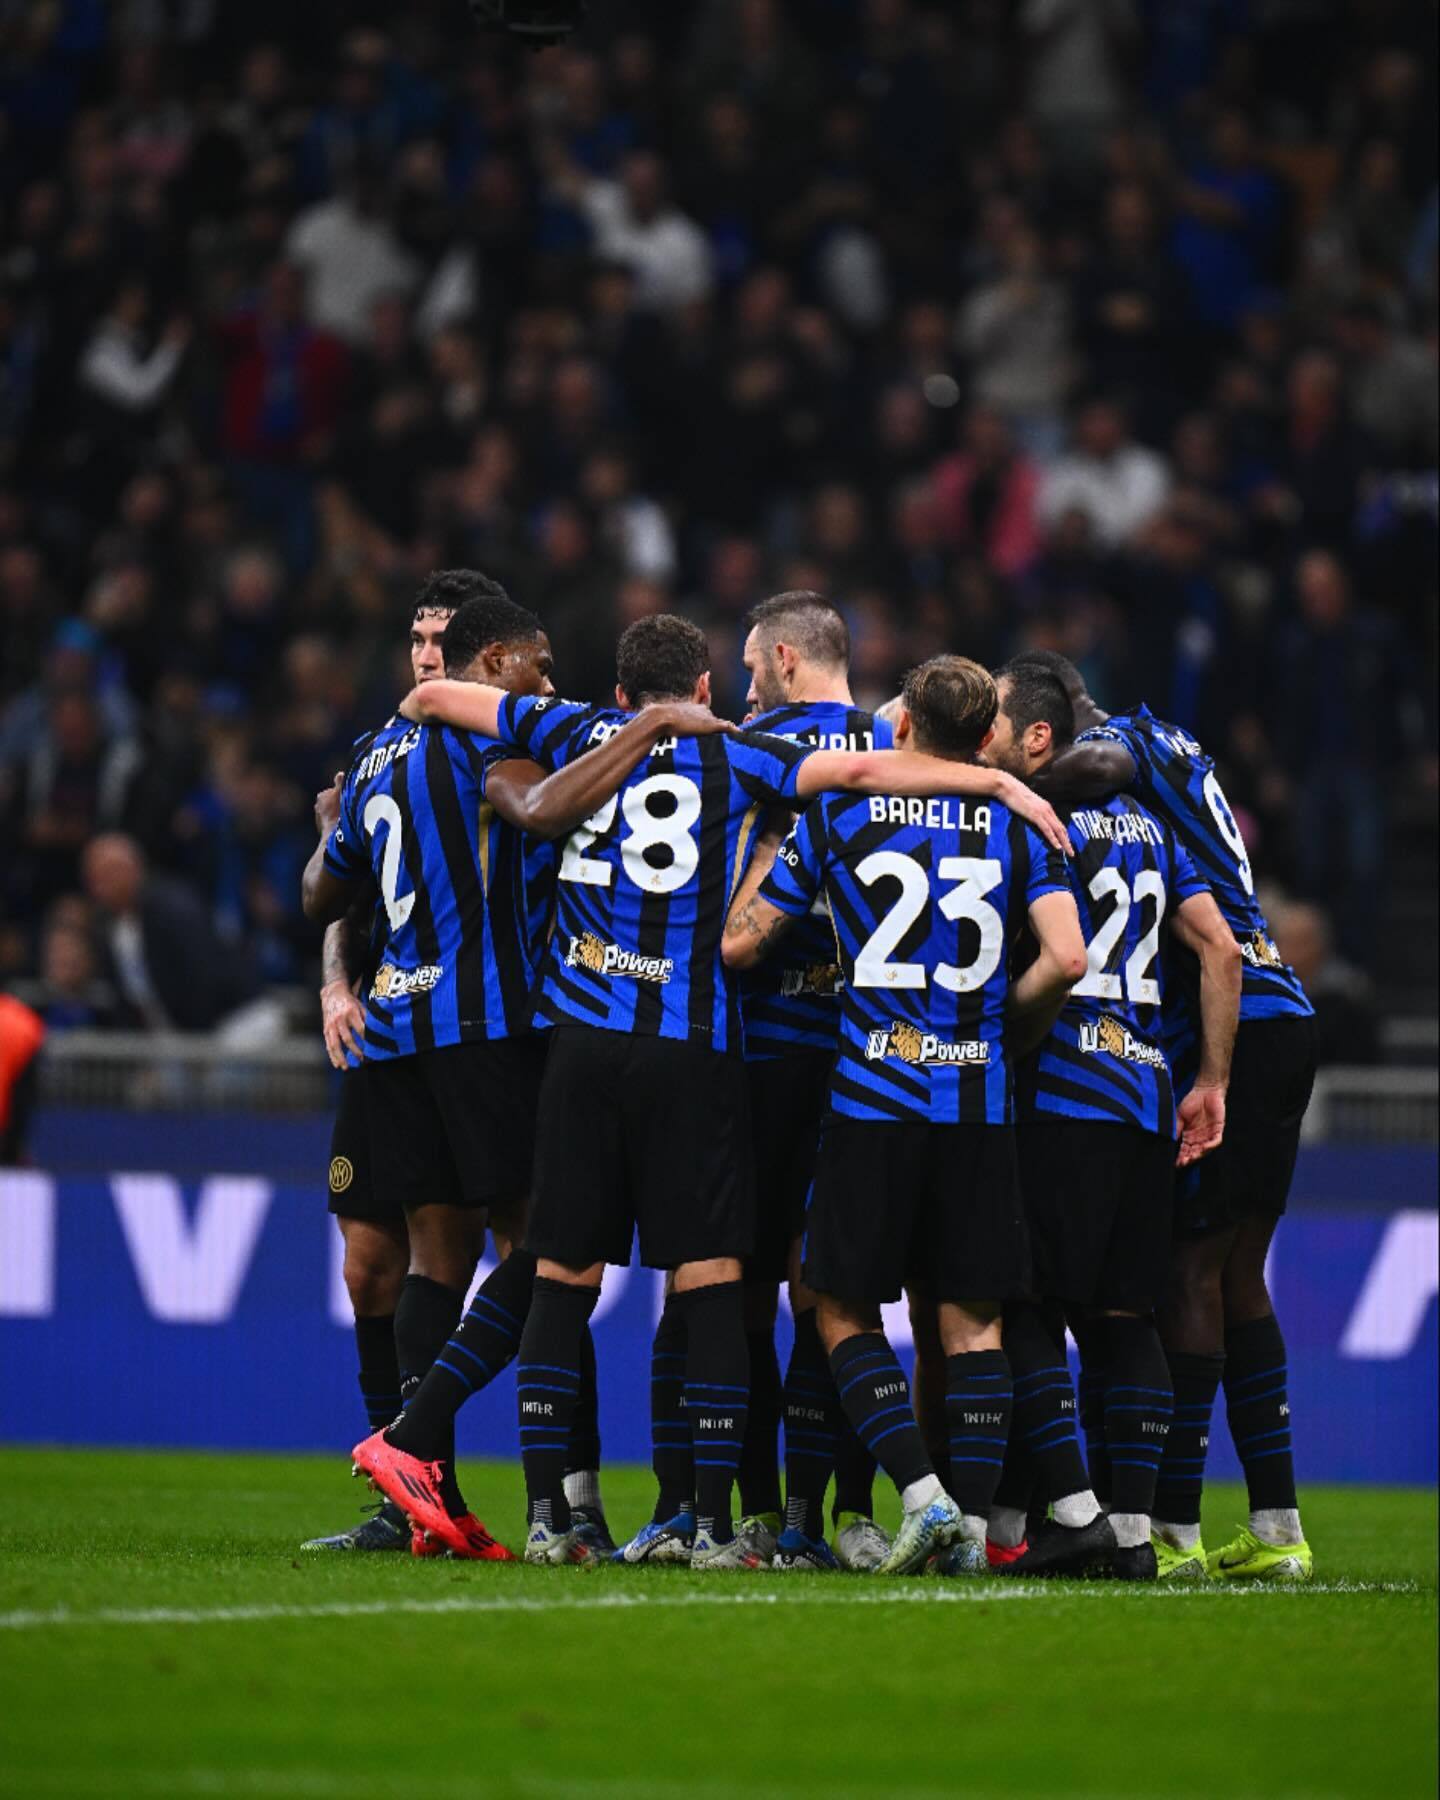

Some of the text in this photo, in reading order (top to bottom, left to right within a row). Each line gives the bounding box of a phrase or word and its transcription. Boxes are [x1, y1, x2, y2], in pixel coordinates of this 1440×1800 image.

[364, 793, 415, 932] 2
[558, 773, 701, 893] 28
[869, 797, 991, 835] BARELLA
[853, 850, 1004, 993] 23
[1070, 866, 1166, 1006] 22
[522, 1401, 553, 1416] INTER
[699, 1417, 734, 1430] INTER
